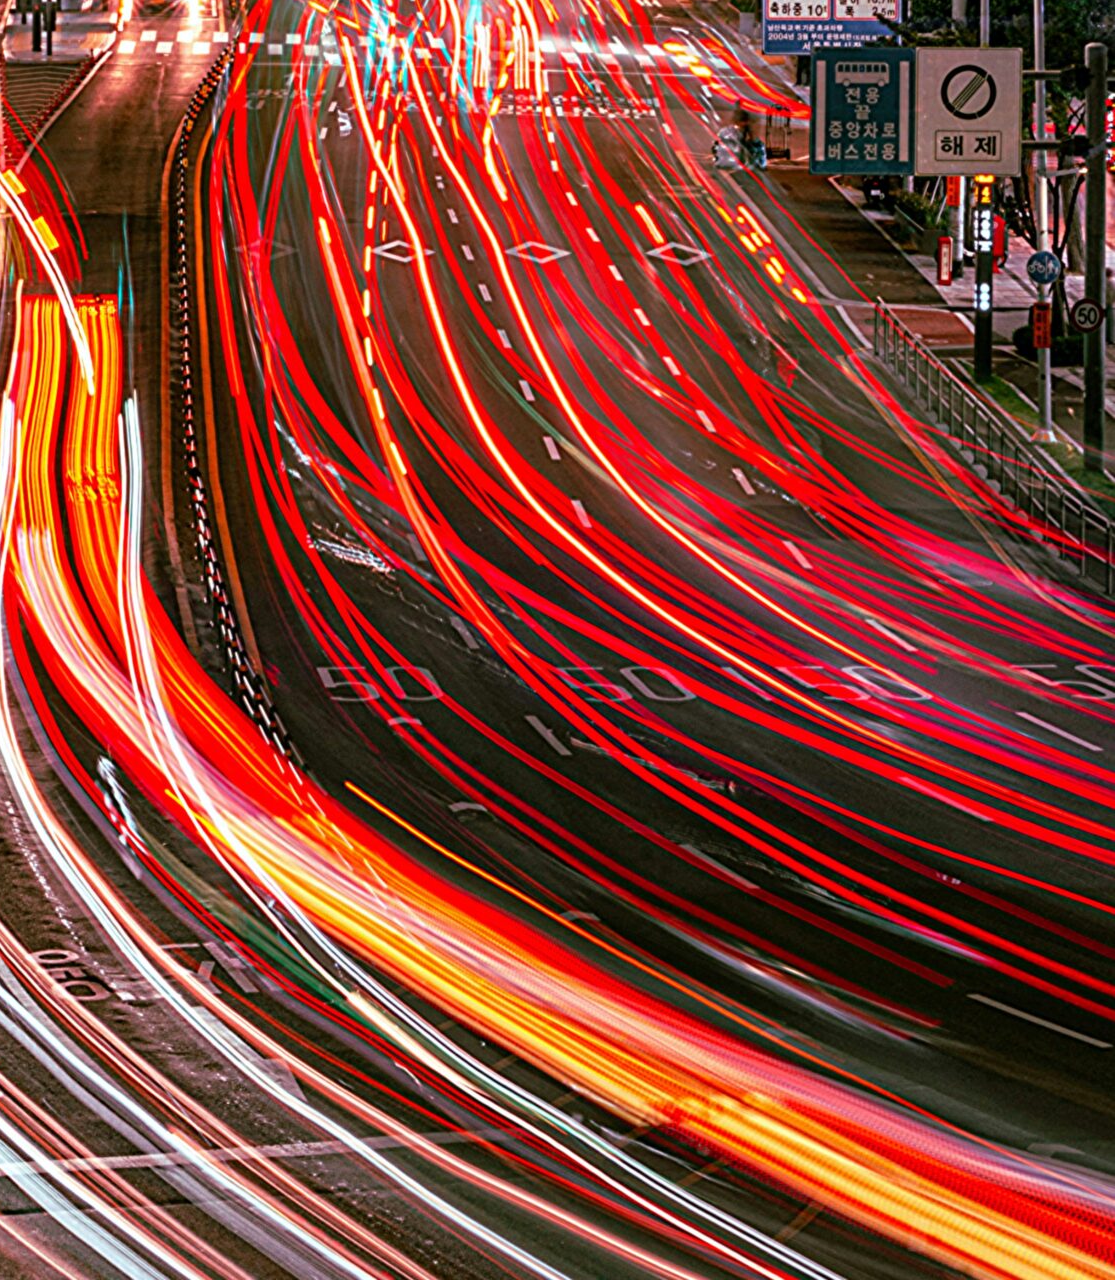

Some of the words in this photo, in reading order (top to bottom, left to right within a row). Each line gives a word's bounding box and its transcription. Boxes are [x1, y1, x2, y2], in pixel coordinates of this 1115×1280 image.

[770, 2, 803, 16] 축하중
[872, 7, 896, 16] 25m
[844, 87, 880, 104] 전용
[854, 105, 871, 120] 끝
[828, 121, 897, 139] 중앙차로
[828, 143, 897, 160] 버스전용
[940, 134, 997, 157] 해제
[1078, 307, 1098, 325] 50
[316, 665, 444, 702] 50
[559, 665, 697, 703] 50
